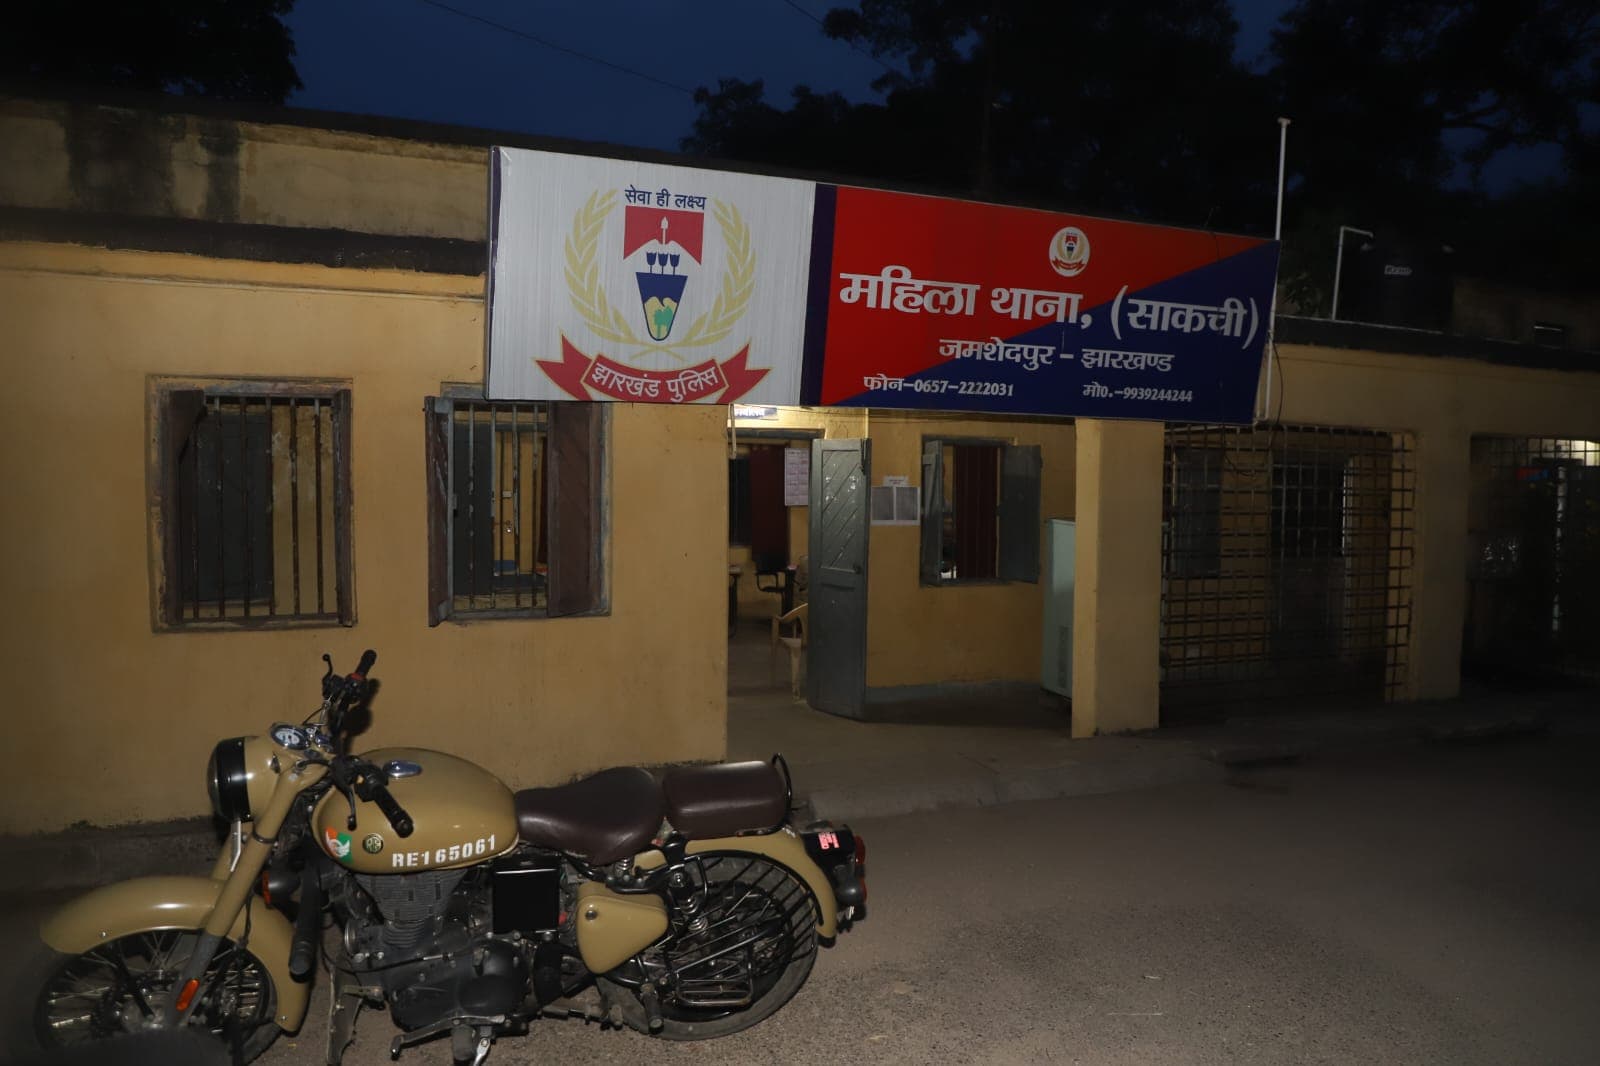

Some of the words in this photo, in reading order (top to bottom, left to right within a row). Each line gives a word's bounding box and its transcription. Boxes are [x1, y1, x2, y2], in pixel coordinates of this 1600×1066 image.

[624, 184, 652, 205] सेवा
[656, 188, 671, 207] ही
[674, 194, 707, 210] लक्ष्य
[839, 265, 982, 316] महिला
[991, 287, 1093, 330] थाना,
[1110, 284, 1259, 350] (साकची)
[939, 337, 1056, 371] जमशेदपुर
[1080, 348, 1175, 372] झारखण्ड
[592, 362, 661, 397] झारखंड
[666, 364, 718, 402] पुलिस
[391, 834, 496, 868] RE165061
